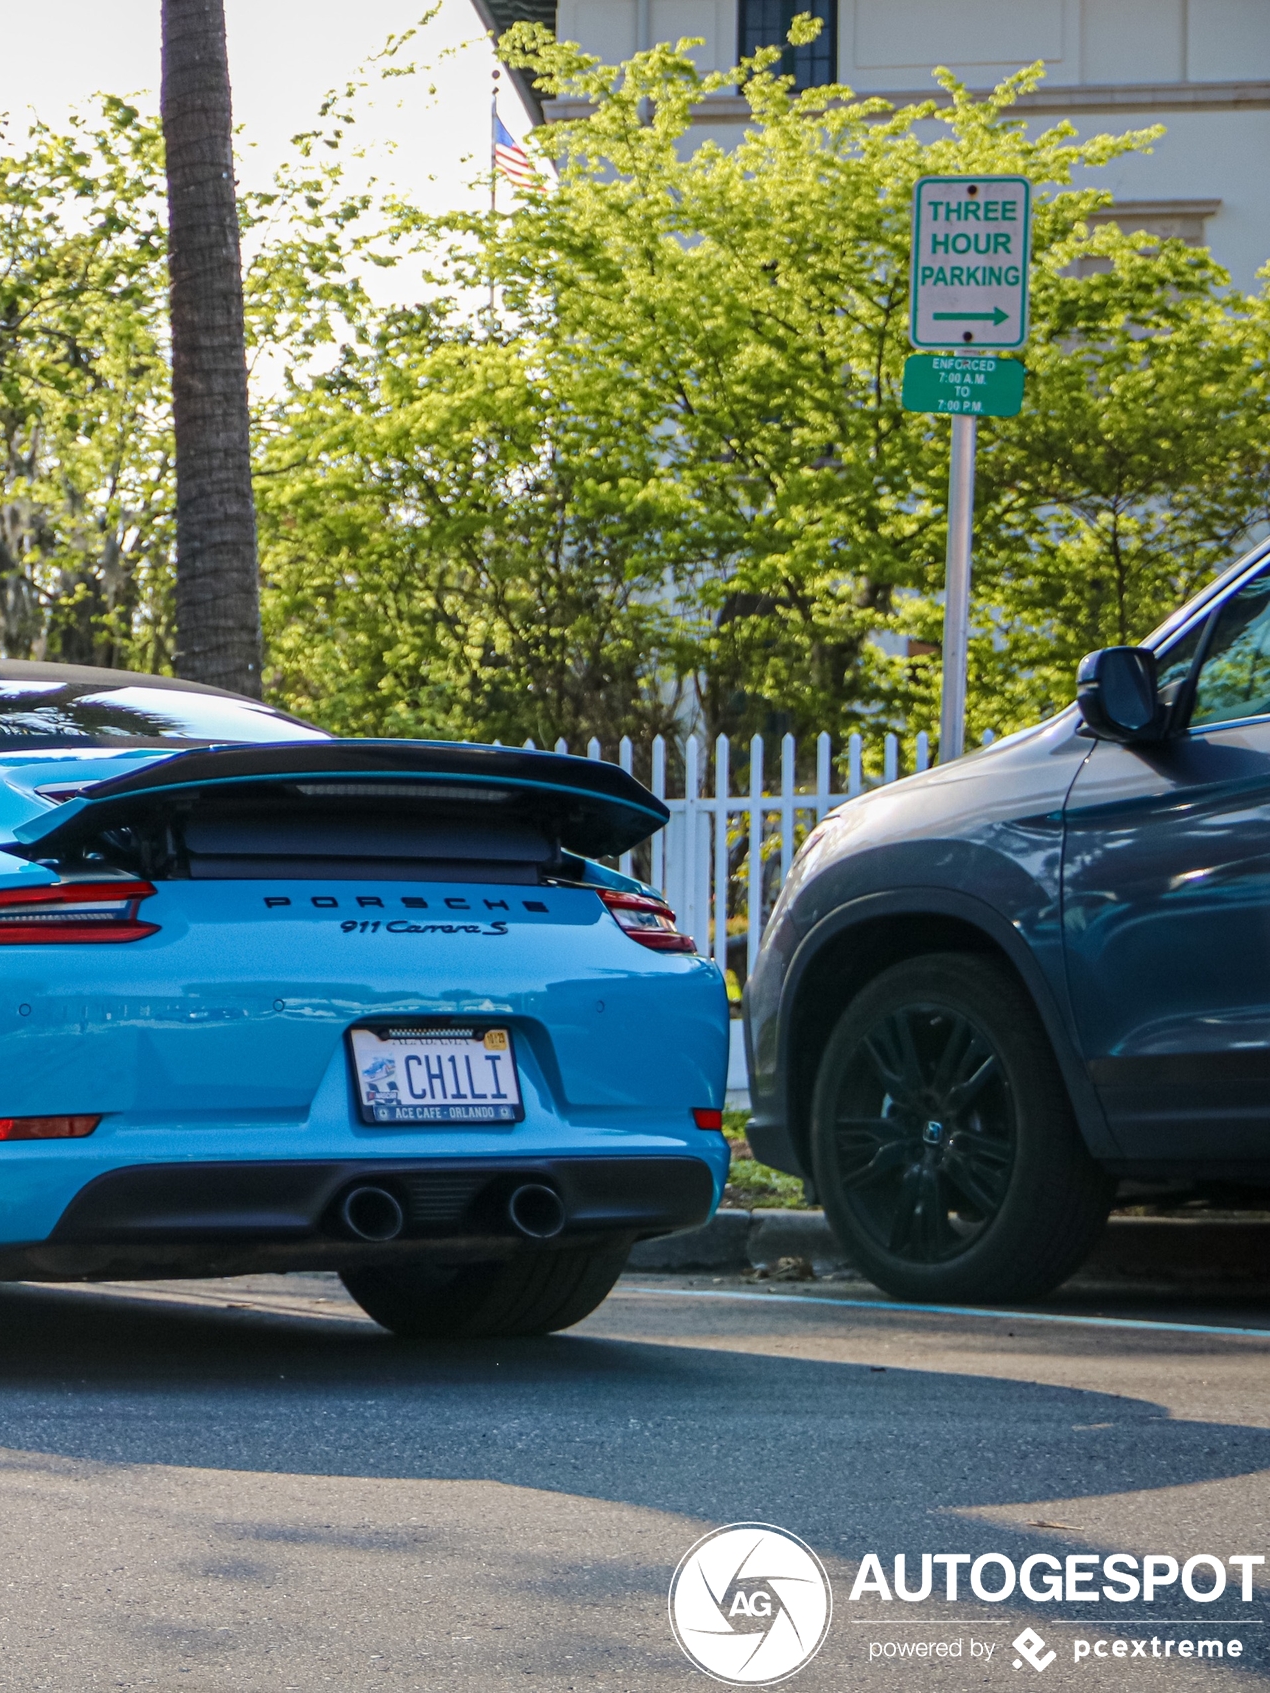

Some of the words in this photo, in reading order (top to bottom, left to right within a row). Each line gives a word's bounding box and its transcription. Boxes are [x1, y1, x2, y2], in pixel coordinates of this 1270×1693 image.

[928, 201, 1017, 221] THREE
[931, 233, 1012, 254] HOUR
[920, 265, 1020, 286] PARKING
[932, 358, 996, 372] ENFORCED
[938, 372, 962, 384] 7:00
[963, 373, 987, 385] A.M.
[954, 385, 971, 398] TO
[937, 399, 961, 412] 7:00
[962, 400, 984, 413] P.M.
[263, 896, 550, 913] PORSCHE
[340, 920, 382, 934] 911
[385, 920, 481, 934] Carrera
[481, 921, 509, 936] S
[395, 1107, 415, 1119] ACE
[417, 1107, 442, 1119] CAFE
[449, 1106, 494, 1118] ORLANDO
